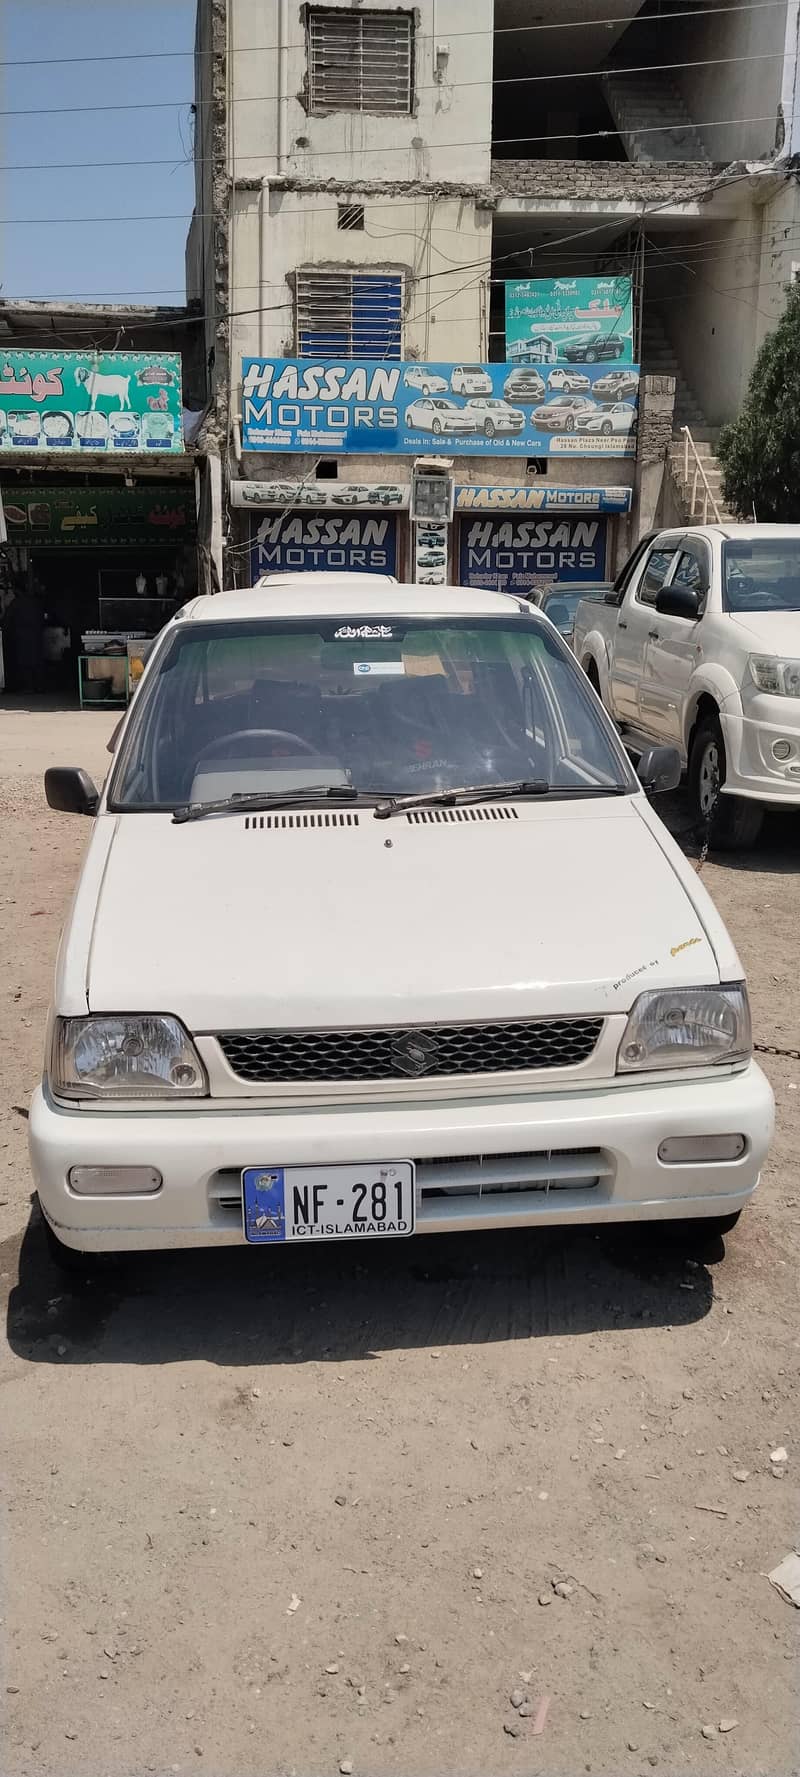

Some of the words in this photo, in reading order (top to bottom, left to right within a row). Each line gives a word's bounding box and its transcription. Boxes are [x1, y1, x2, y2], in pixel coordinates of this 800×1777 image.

[243, 363, 401, 402] HASSAN
[244, 399, 399, 428] MOTORS
[403, 437, 421, 445] Deals
[432, 437, 446, 445] Sale
[455, 438, 484, 446] Purchase
[493, 438, 504, 447] Old
[511, 439, 526, 447] New
[457, 488, 545, 509] HASSAN
[546, 490, 600, 504] MOTORS
[257, 517, 389, 546] HASSAN
[467, 521, 599, 548] HASSAN
[258, 544, 387, 567] MOTORS
[468, 548, 596, 568] MOTORS
[292, 1221, 408, 1236] ICT-ISLAMABAD
